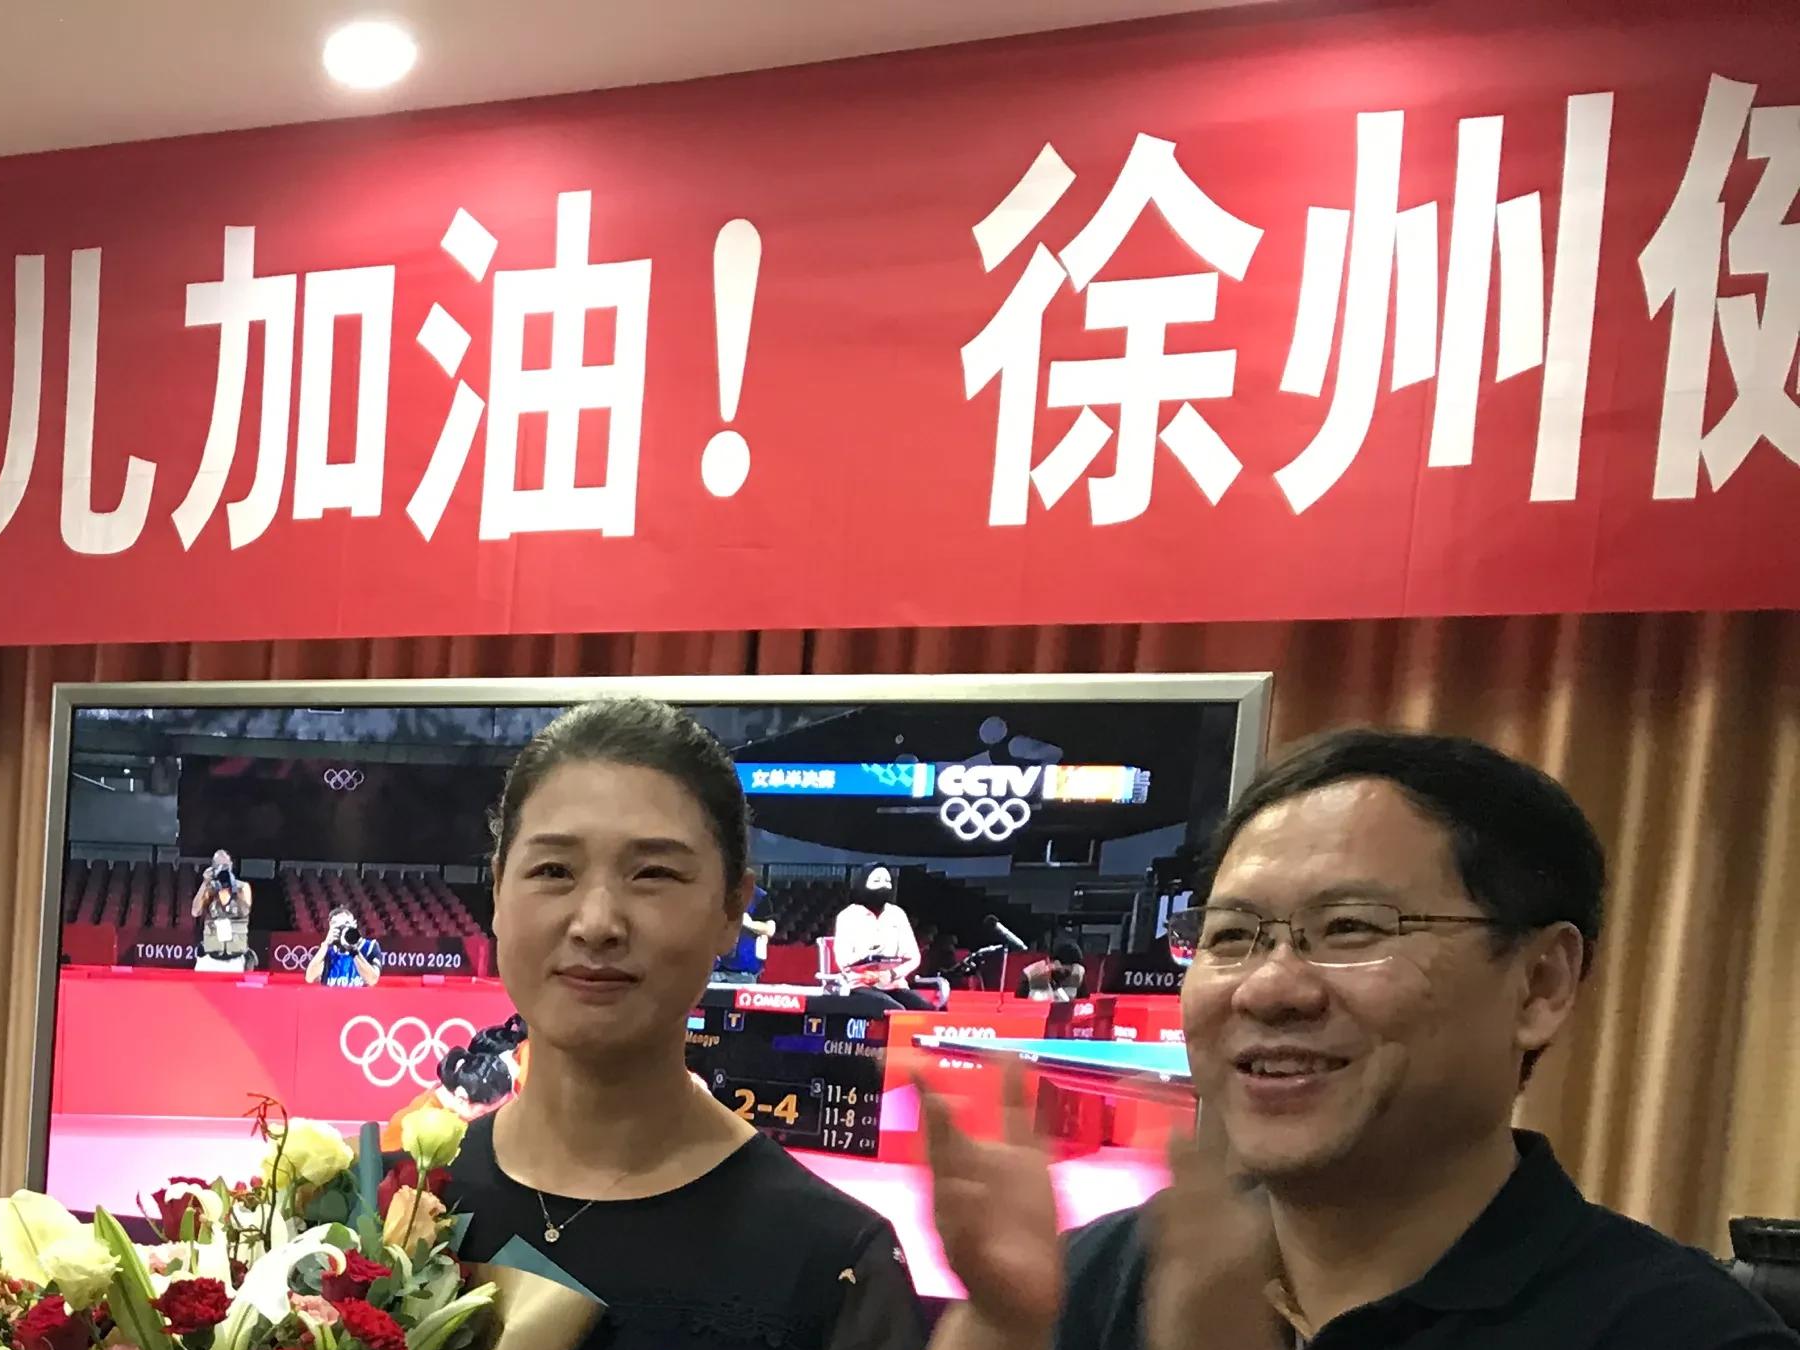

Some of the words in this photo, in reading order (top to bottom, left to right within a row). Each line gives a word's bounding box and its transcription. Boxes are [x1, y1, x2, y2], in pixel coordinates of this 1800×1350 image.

[938, 765, 1041, 797] CCTV
[136, 943, 183, 959] TOKYO
[381, 951, 425, 967] TOKYO
[427, 953, 462, 969] 2020
[1123, 970, 1174, 988] TOKYO
[846, 1018, 867, 1039] CHN
[824, 1040, 852, 1055] CHEN
[827, 1084, 857, 1105] 11-6
[734, 1088, 799, 1125] 2-4
[825, 1107, 855, 1128] 11-8
[823, 1129, 853, 1149] 11-7
